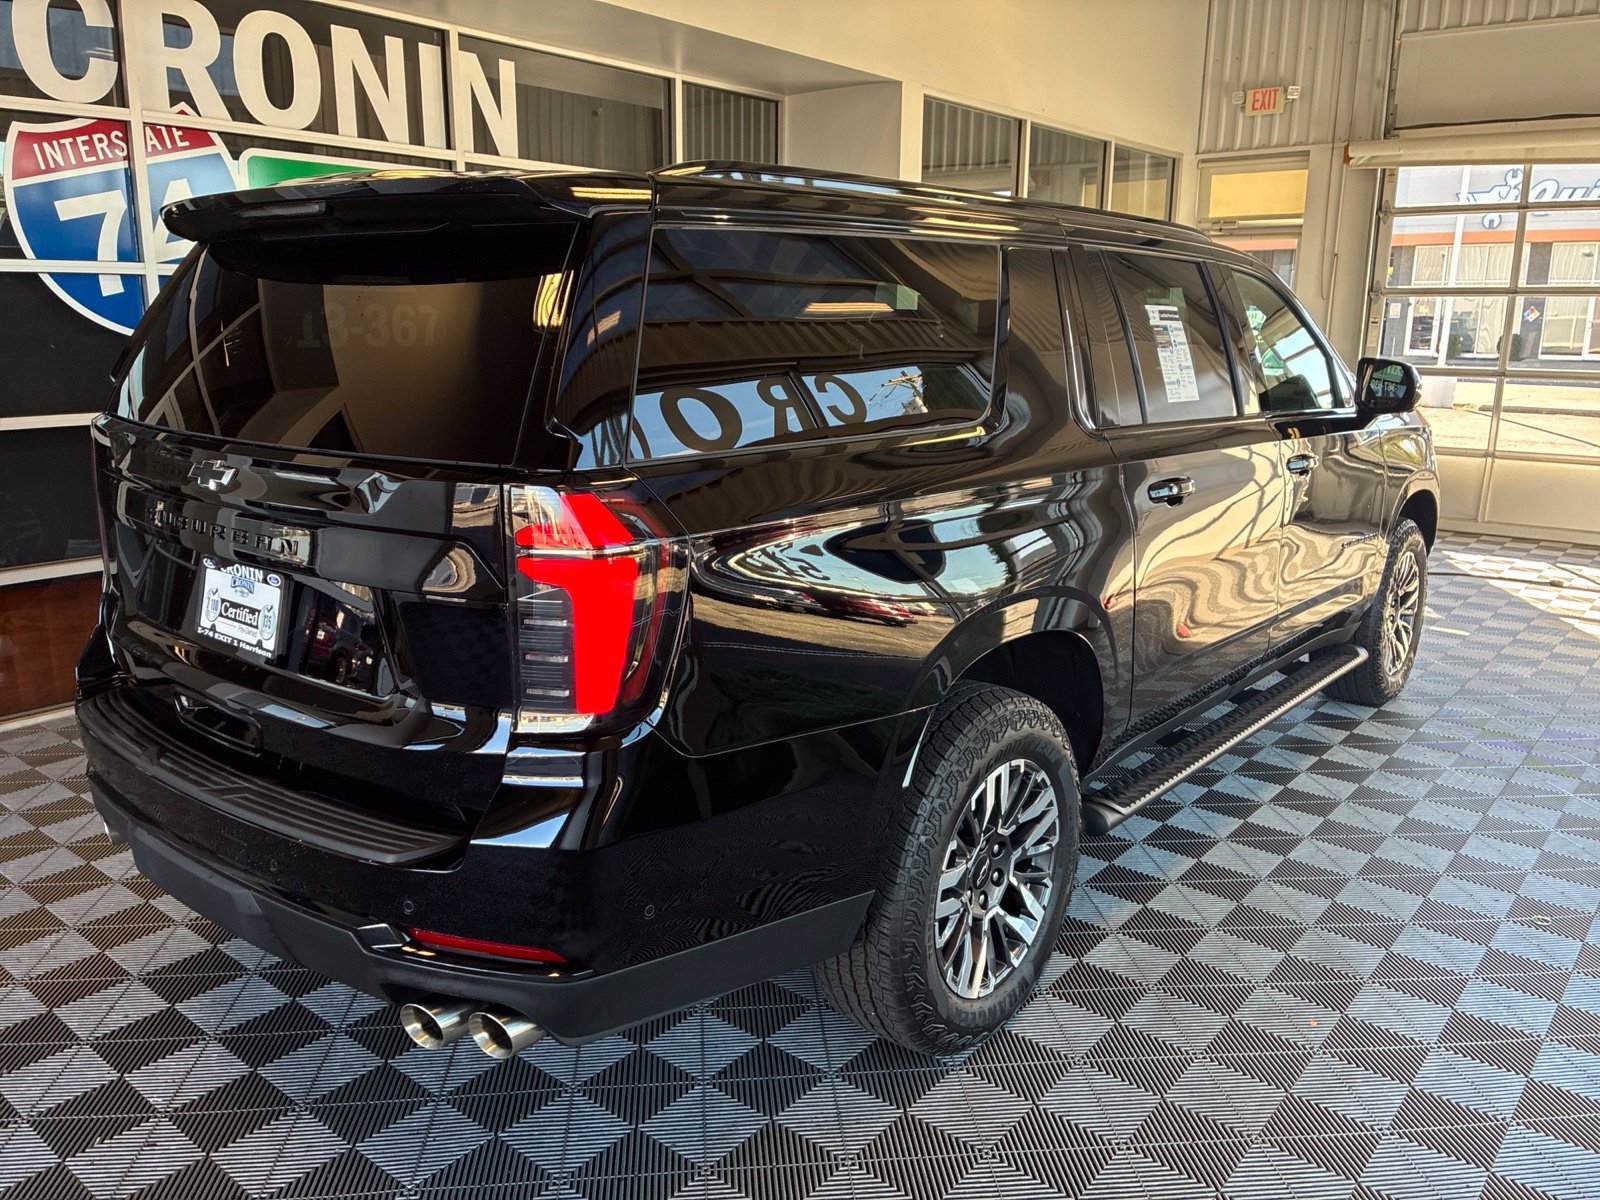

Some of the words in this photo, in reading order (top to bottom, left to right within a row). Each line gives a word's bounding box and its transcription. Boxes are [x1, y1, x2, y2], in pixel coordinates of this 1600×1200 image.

[12, 0, 518, 158] CRONIN
[1251, 87, 1280, 111] EXIT
[32, 126, 190, 170] INTERSATE
[221, 602, 258, 626] Certified
[197, 626, 213, 638] I-74
[214, 632, 233, 644] EXIT
[233, 639, 239, 647] 1
[239, 641, 272, 658] Harrison
